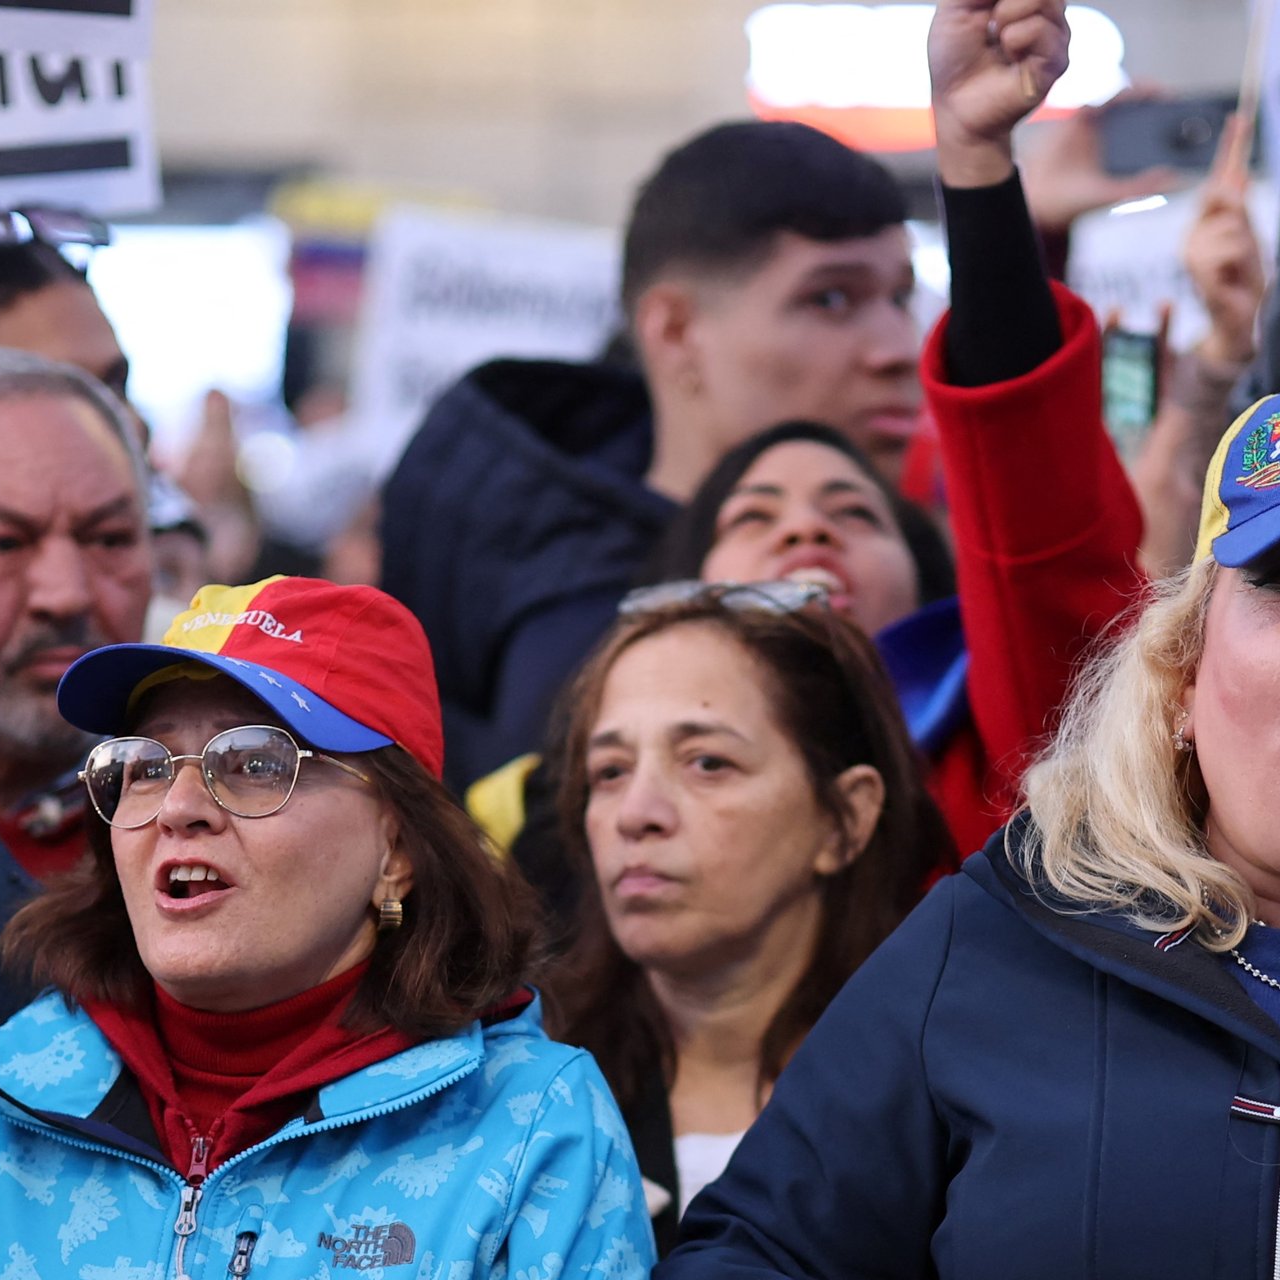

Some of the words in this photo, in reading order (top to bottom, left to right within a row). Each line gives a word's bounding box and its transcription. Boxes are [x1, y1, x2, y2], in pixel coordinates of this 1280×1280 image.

[182, 609, 303, 644] VENEZUELA
[351, 1223, 390, 1240] THE
[317, 1231, 384, 1255] NORTH
[332, 1251, 384, 1271] FACE
